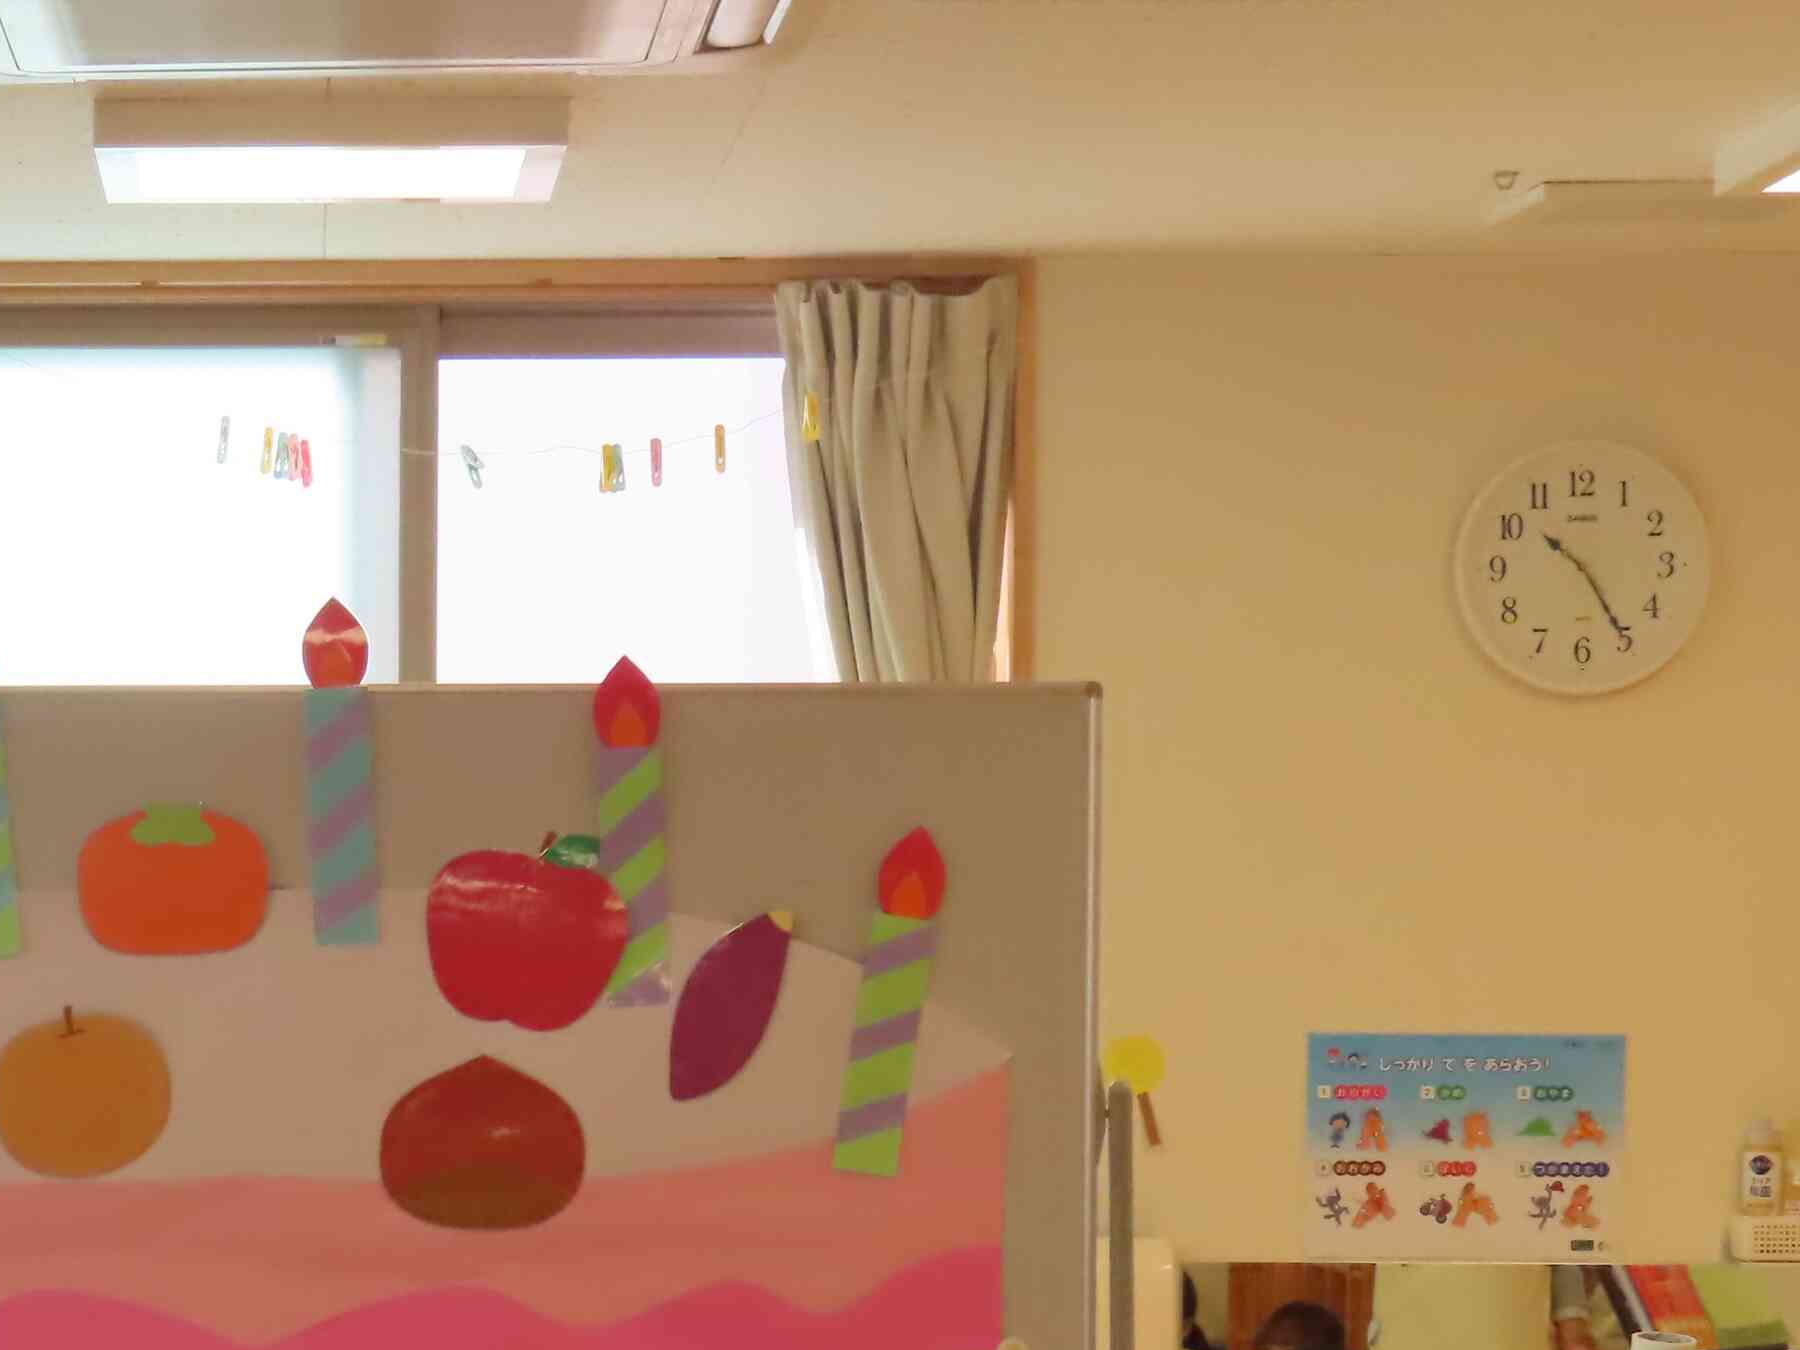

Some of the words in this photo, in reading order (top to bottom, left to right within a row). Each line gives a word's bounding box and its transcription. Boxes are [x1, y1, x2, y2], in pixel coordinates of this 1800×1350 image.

[1530, 482, 1548, 510] 11
[1567, 469, 1595, 498] 12
[1618, 480, 1628, 507] 1
[1500, 513, 1524, 541] 10
[1646, 509, 1664, 537] 2
[1488, 555, 1507, 583] 9
[1656, 551, 1675, 579] 3
[1501, 596, 1518, 624] 8
[1642, 593, 1660, 619] 4
[1532, 628, 1548, 654] 7
[1573, 636, 1591, 664] 6
[1616, 625, 1633, 652] 5
[1379, 1056, 1434, 1072] しっかり
[1442, 1057, 1456, 1072] て
